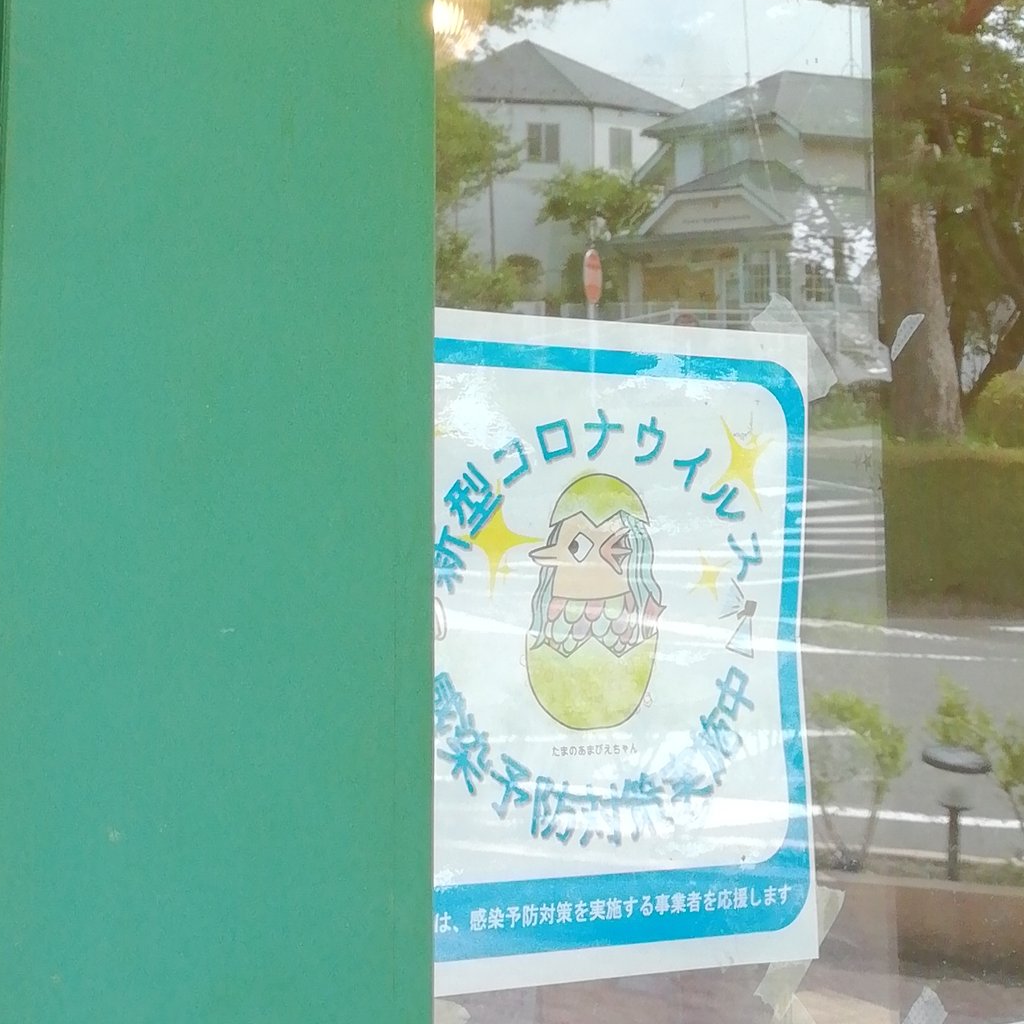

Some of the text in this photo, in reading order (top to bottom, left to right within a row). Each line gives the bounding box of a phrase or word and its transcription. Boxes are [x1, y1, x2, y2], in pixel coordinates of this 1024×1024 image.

[551, 743, 638, 757] たまのあまびえちゃん
[434, 884, 792, 933] は、感染予防対策を実施する事業者を応援します
